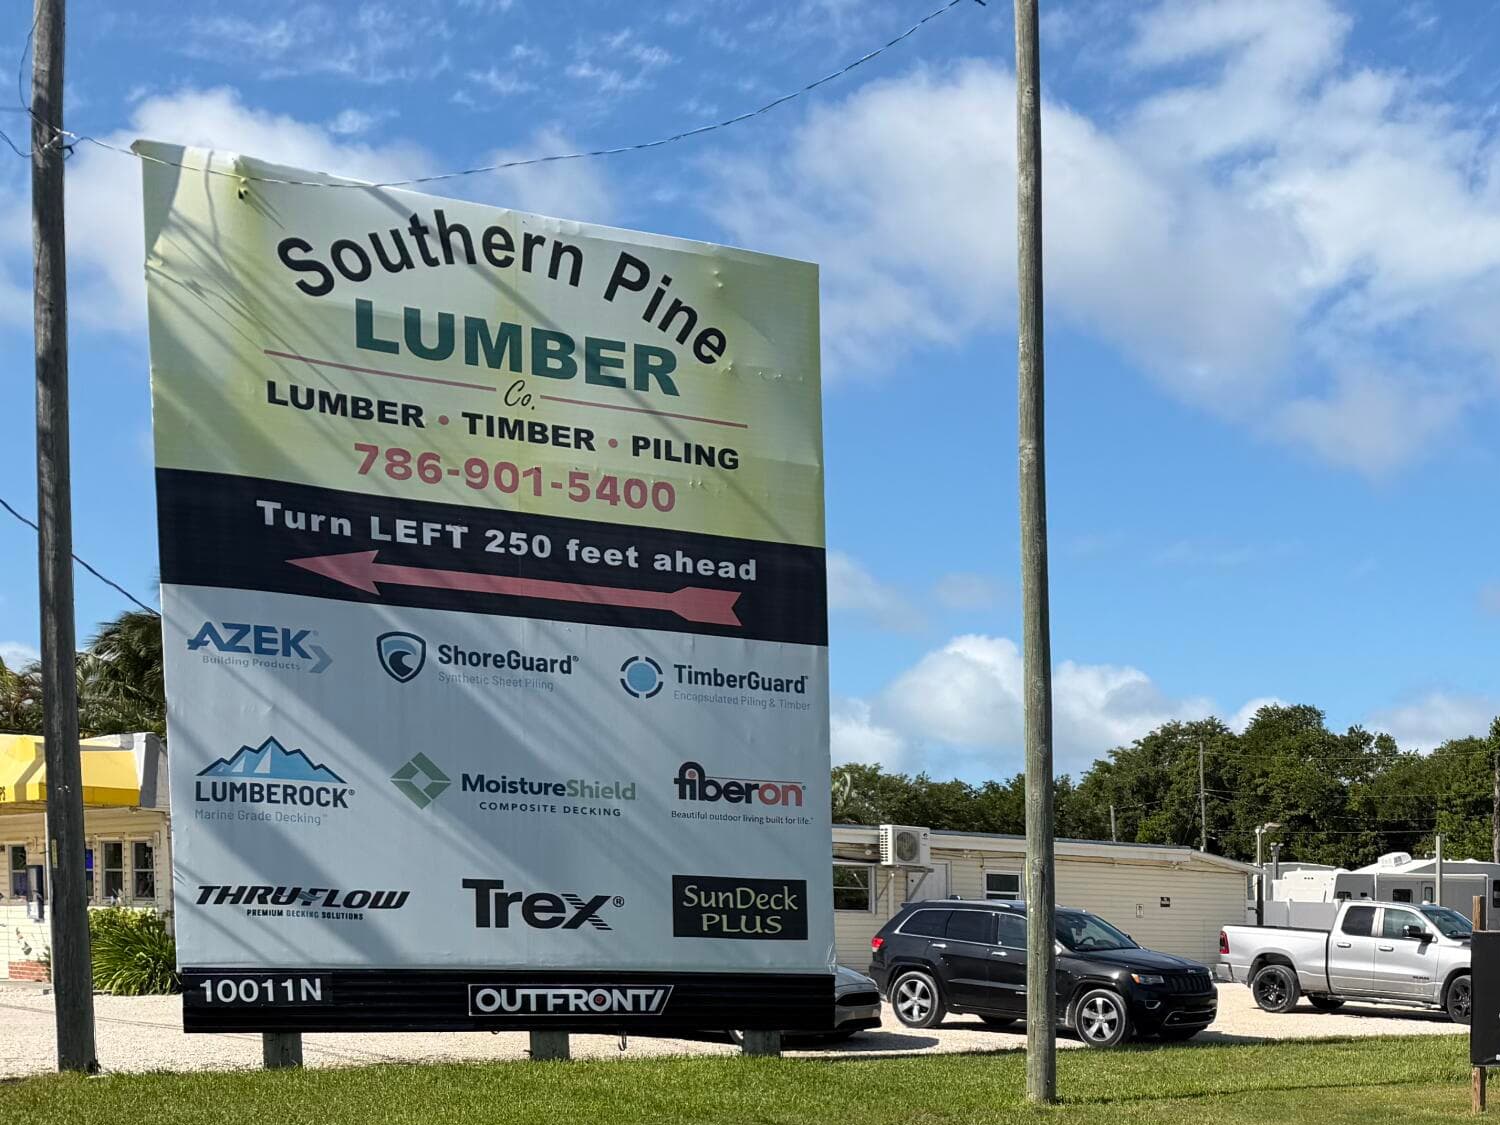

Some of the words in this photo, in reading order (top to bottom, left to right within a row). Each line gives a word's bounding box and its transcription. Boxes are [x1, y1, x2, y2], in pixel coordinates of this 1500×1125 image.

[277, 209, 585, 297] Southern
[602, 251, 727, 366] Pine
[354, 298, 681, 397] LUMBER
[503, 379, 536, 411] Co.
[266, 380, 425, 428] LUMBER
[461, 411, 596, 451] TIMBER
[631, 434, 740, 470] PILING
[353, 441, 676, 513] 786-901-5400
[255, 499, 353, 538] Turn
[369, 515, 469, 549] LEFT
[484, 527, 553, 560] 250
[566, 539, 639, 570] feet
[652, 550, 758, 582] ahead
[187, 621, 313, 660] AZEK
[202, 655, 250, 669] Building
[252, 657, 302, 672] Products
[438, 672, 490, 687] Synthetic
[491, 675, 523, 688] Sheet
[524, 680, 555, 692] Piling
[673, 690, 739, 706] Encapsulated
[740, 695, 768, 710] Piling
[768, 698, 777, 708] &
[780, 698, 811, 711] Timber
[461, 773, 637, 801] MoistureShield
[673, 761, 803, 808] fiberon
[194, 809, 235, 821] Marine
[237, 810, 272, 822] Grade
[479, 801, 558, 814] COMPOSITE
[563, 805, 622, 817] DECKING
[671, 810, 708, 821] Beautiful
[709, 812, 741, 822] outdoor
[742, 814, 765, 825] living
[765, 815, 784, 825] built
[785, 816, 797, 825] for
[683, 883, 799, 911] SunDeck
[246, 909, 284, 917] PREMIUM
[286, 910, 319, 919] DECKING
[321, 911, 364, 921] SOLUTIONS
[700, 913, 783, 935] PLUS
[199, 976, 323, 1003] 10011N
